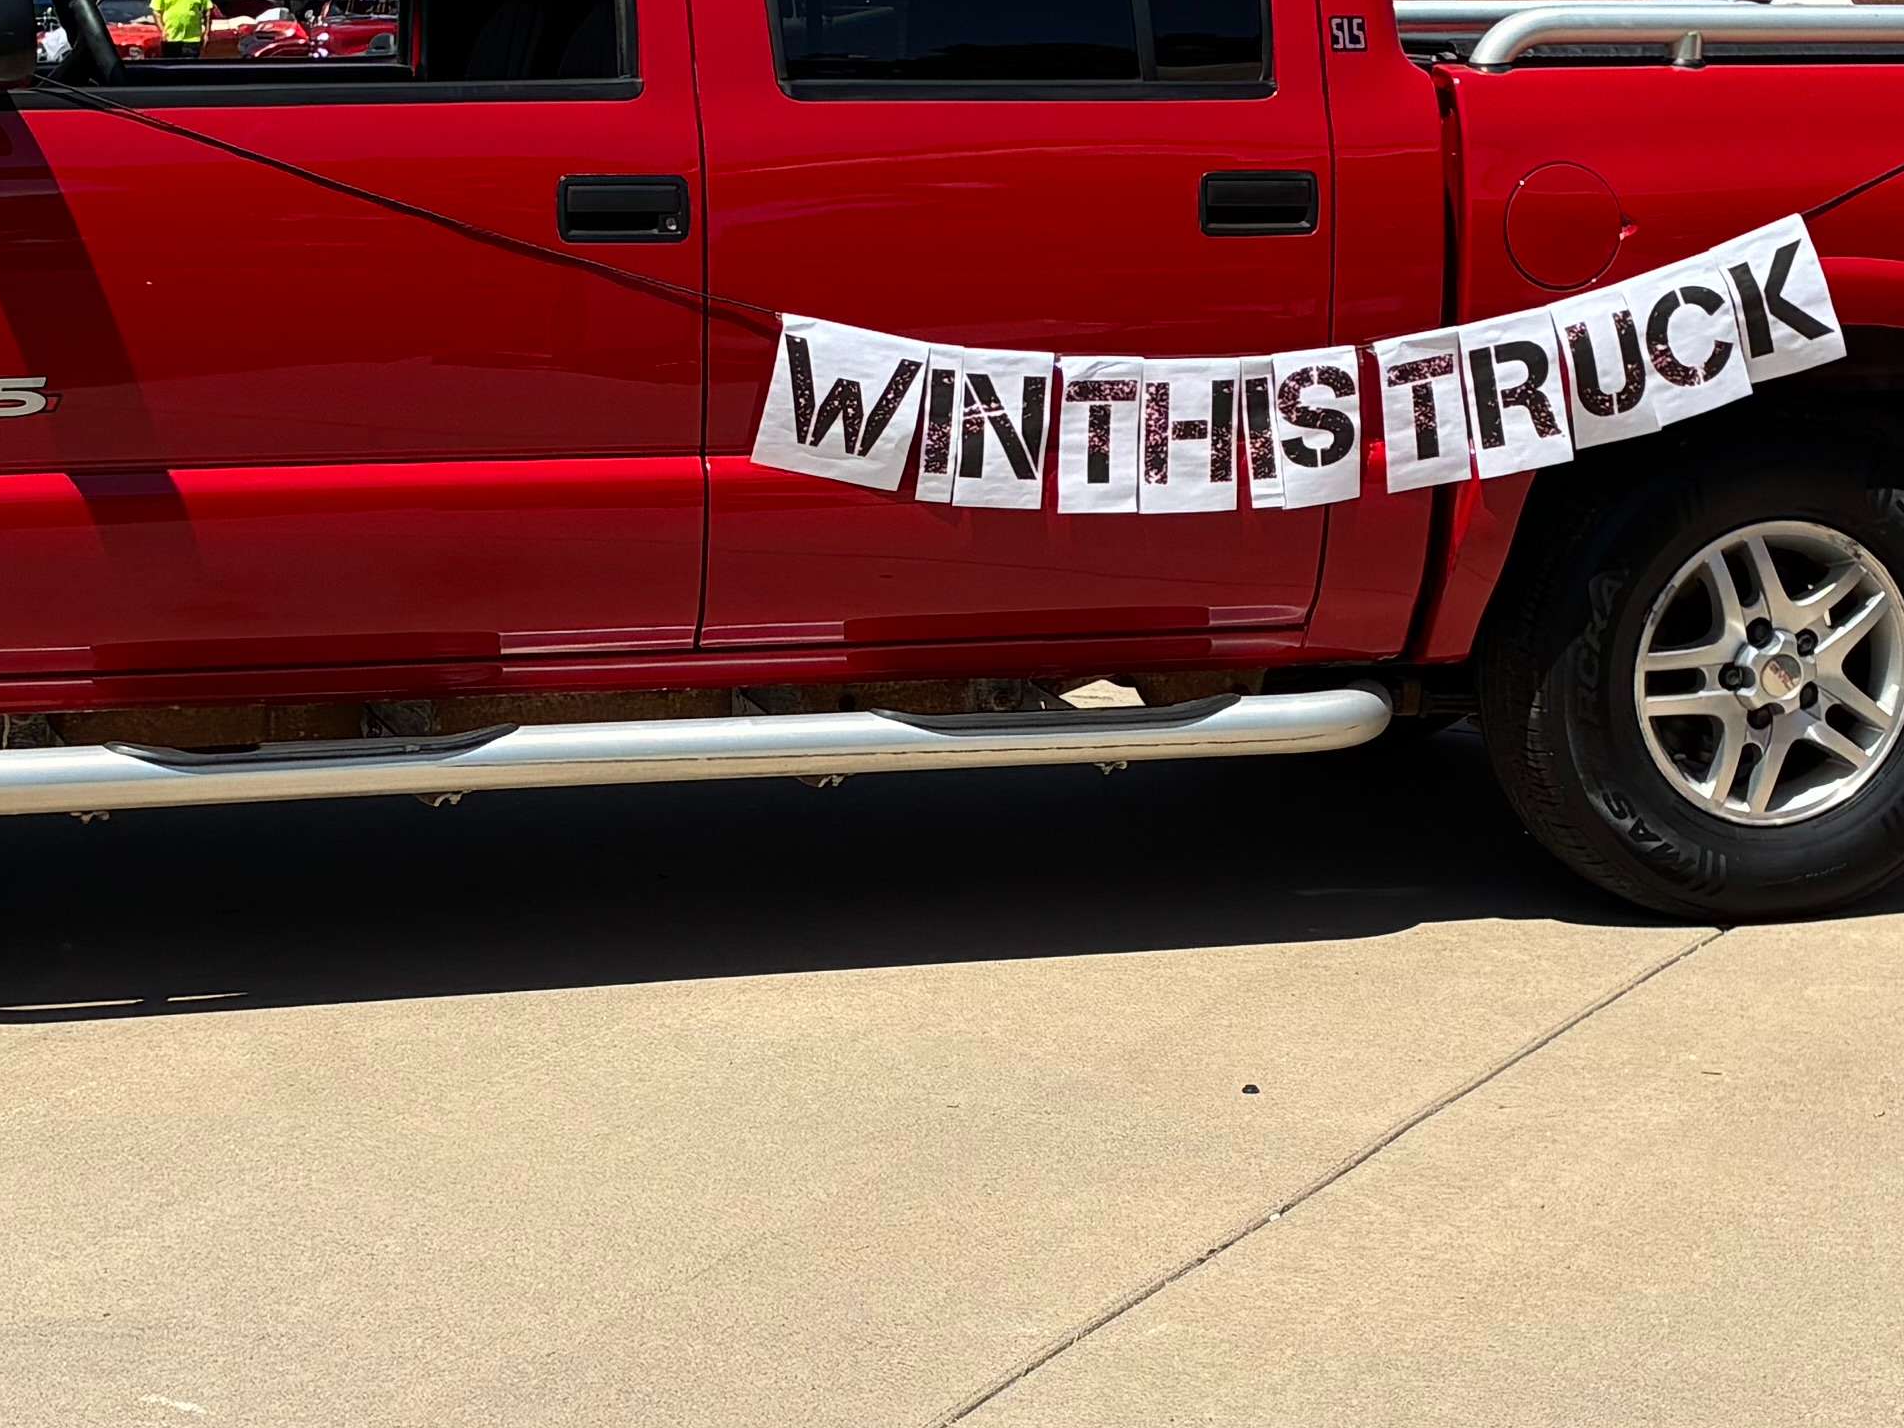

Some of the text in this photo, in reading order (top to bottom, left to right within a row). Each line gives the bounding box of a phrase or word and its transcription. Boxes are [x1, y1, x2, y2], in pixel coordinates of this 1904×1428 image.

[1331, 18, 1365, 49] SLS
[785, 238, 1833, 484] WIN THIS TRUCK
